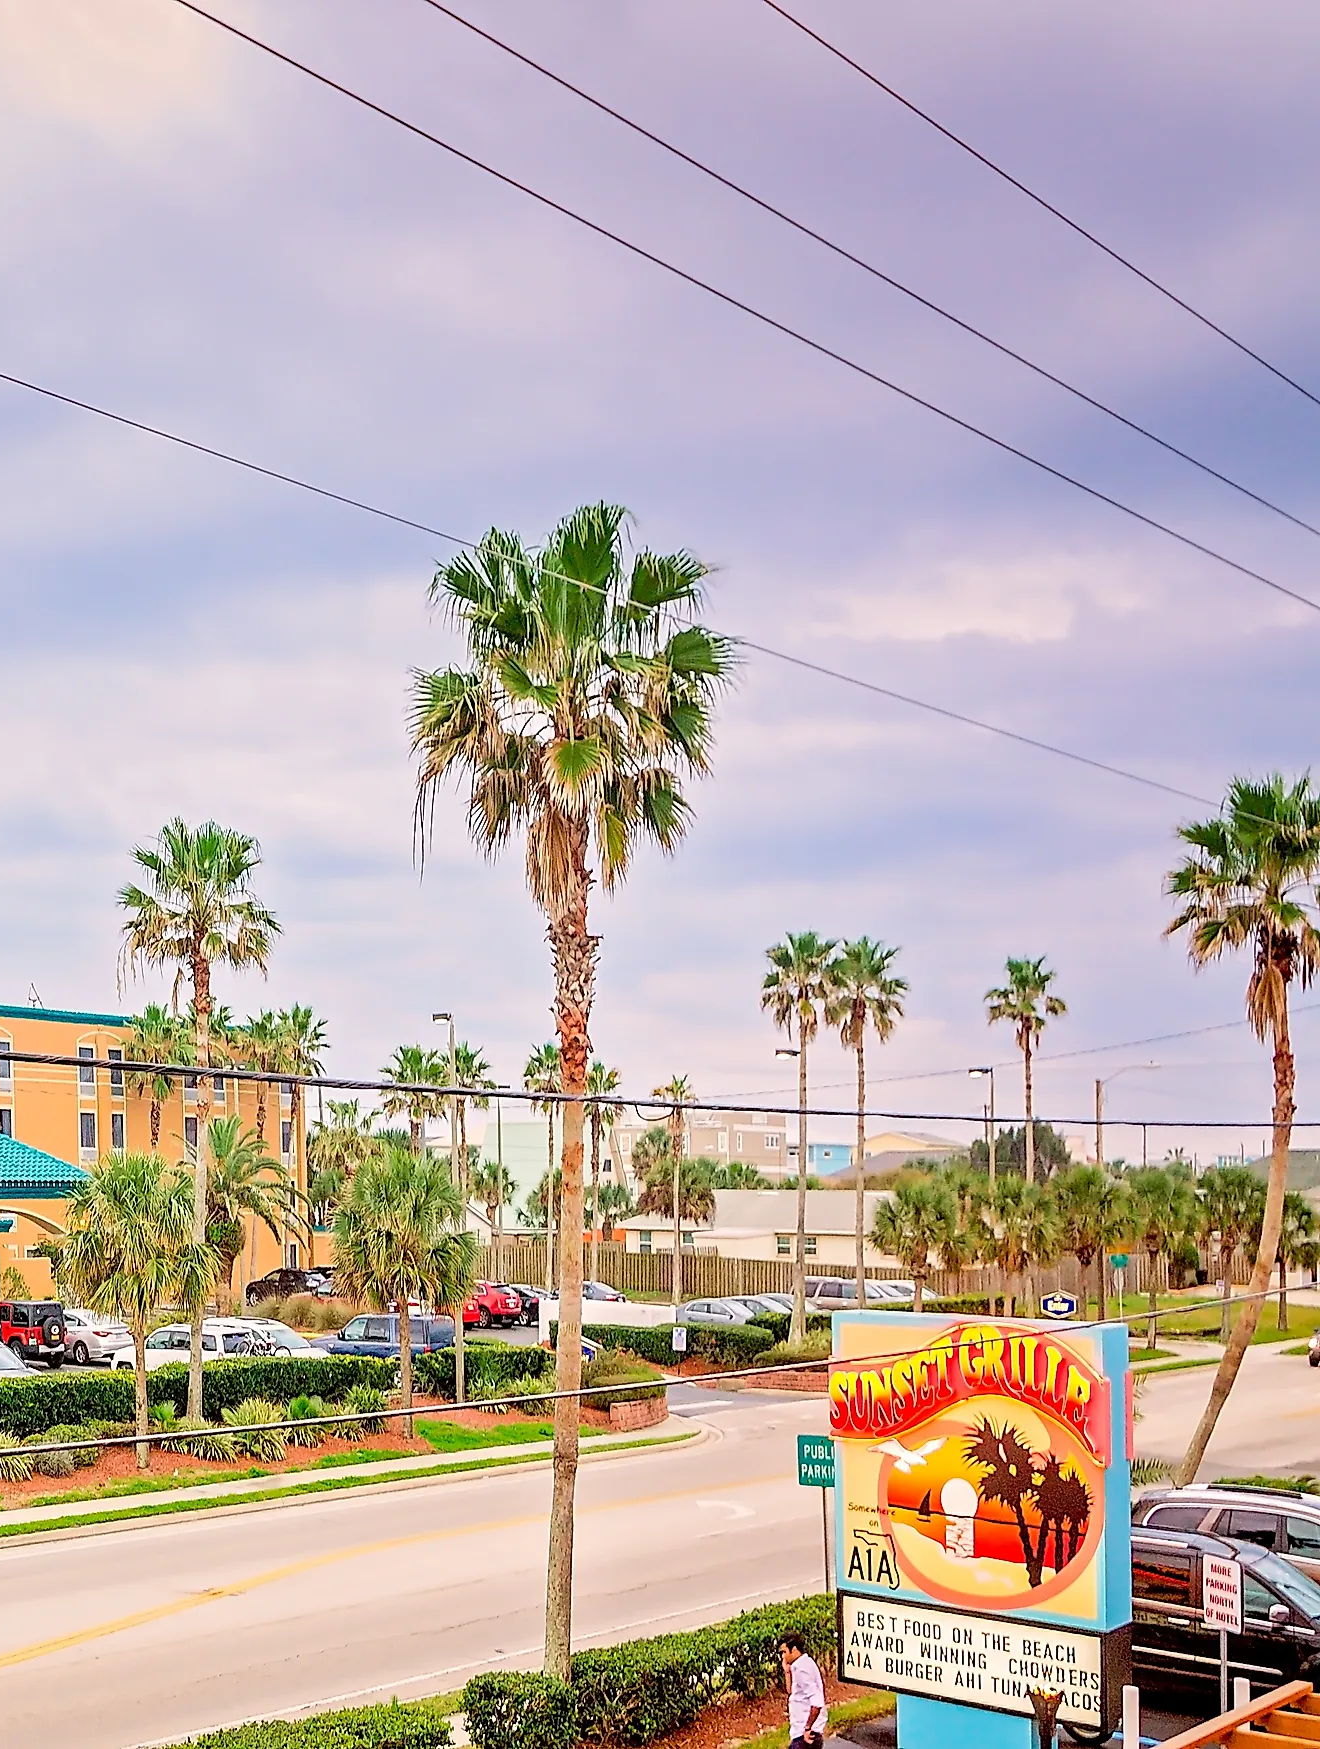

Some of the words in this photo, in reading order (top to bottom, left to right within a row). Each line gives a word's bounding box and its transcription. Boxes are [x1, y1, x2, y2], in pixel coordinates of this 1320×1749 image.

[829, 1336, 953, 1437] SUNSET
[959, 1325, 1095, 1448] GRILLE
[803, 1444, 835, 1460] PUBLI
[848, 1502, 896, 1516] Somewhere
[869, 1519, 879, 1527] on
[847, 1546, 893, 1585] A1A
[1210, 1563, 1232, 1578] MORE
[1205, 1577, 1238, 1595] PARKING
[1209, 1593, 1234, 1609] NORTH
[1205, 1606, 1214, 1618] OF
[857, 1611, 897, 1633] BEST
[904, 1619, 941, 1640] FOOD
[952, 1627, 972, 1645] ON
[981, 1632, 1010, 1653] THE
[1022, 1639, 1076, 1664] BEACH
[850, 1631, 904, 1654] AWARD
[920, 1642, 987, 1670] WINNING
[1009, 1658, 1099, 1690] CHOWDERS
[885, 1657, 943, 1683] BURGER
[954, 1671, 982, 1690] AHI
[1060, 1690, 1101, 1713] ACOS
